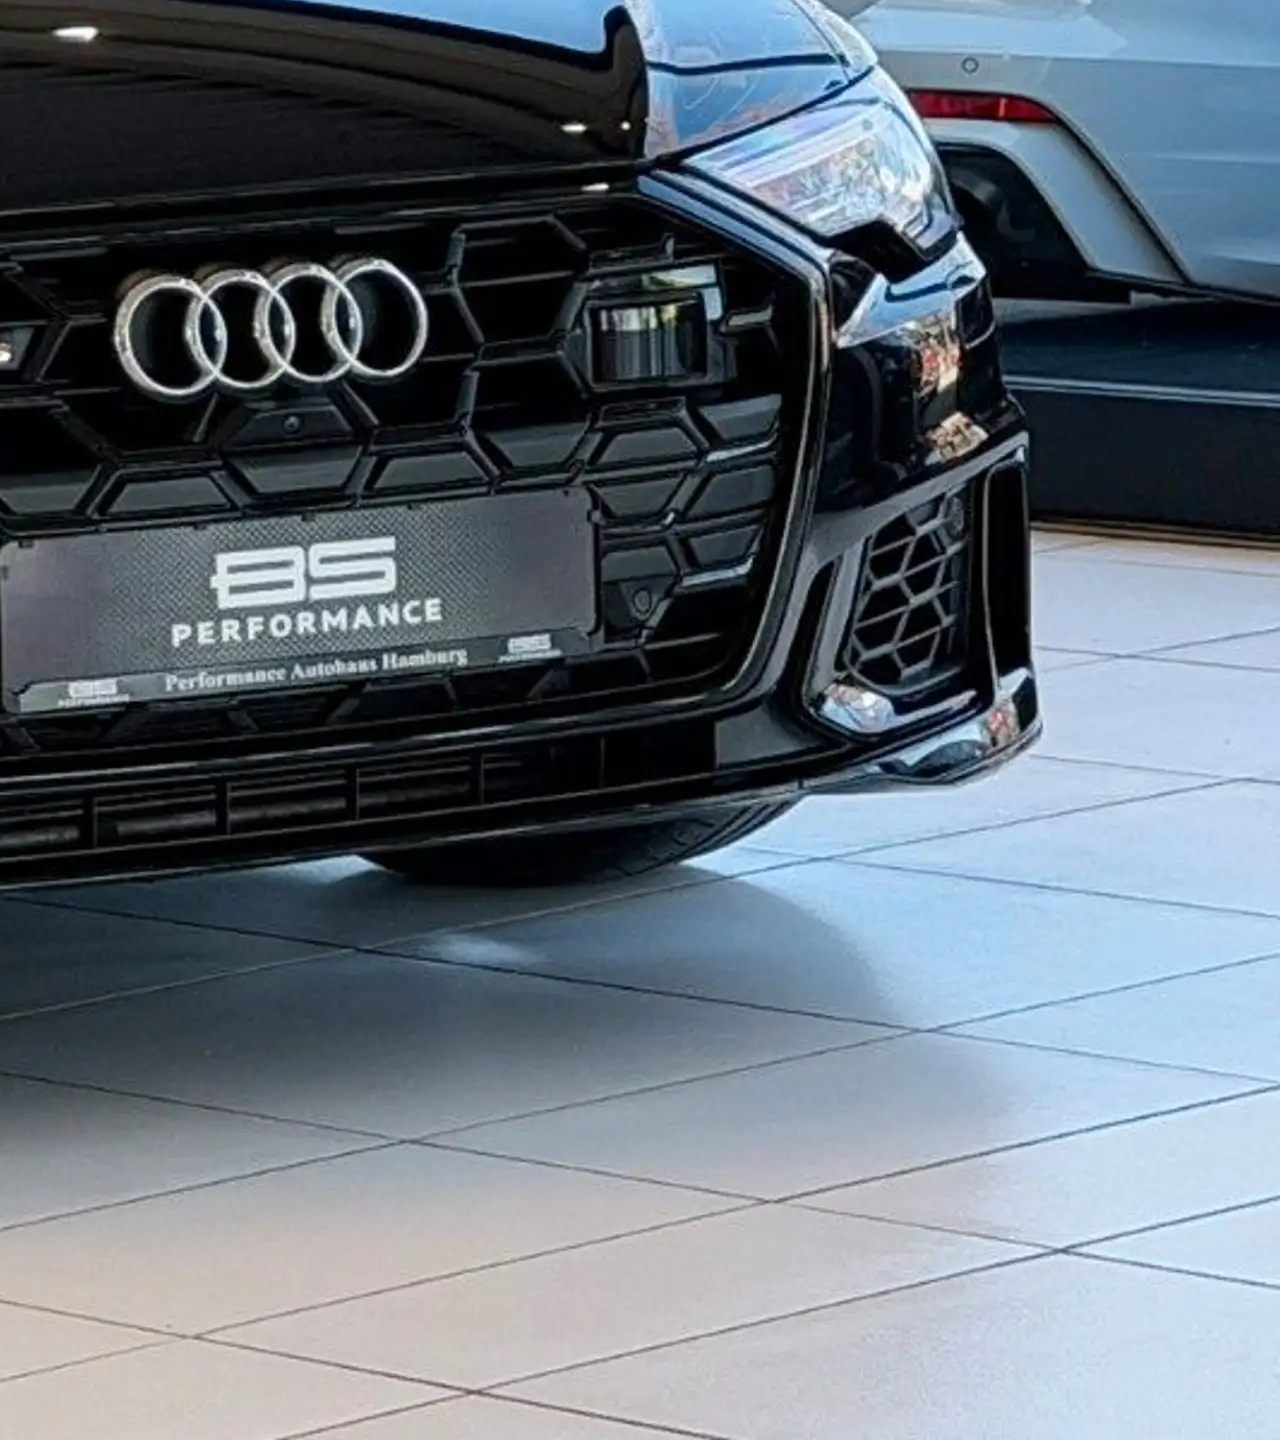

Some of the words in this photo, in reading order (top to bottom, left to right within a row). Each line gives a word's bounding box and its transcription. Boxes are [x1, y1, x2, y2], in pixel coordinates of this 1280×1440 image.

[171, 598, 442, 647] PERFORMANCE
[165, 665, 287, 692] Performance
[291, 658, 378, 680] Autohaus
[383, 648, 468, 669] Hamburg
